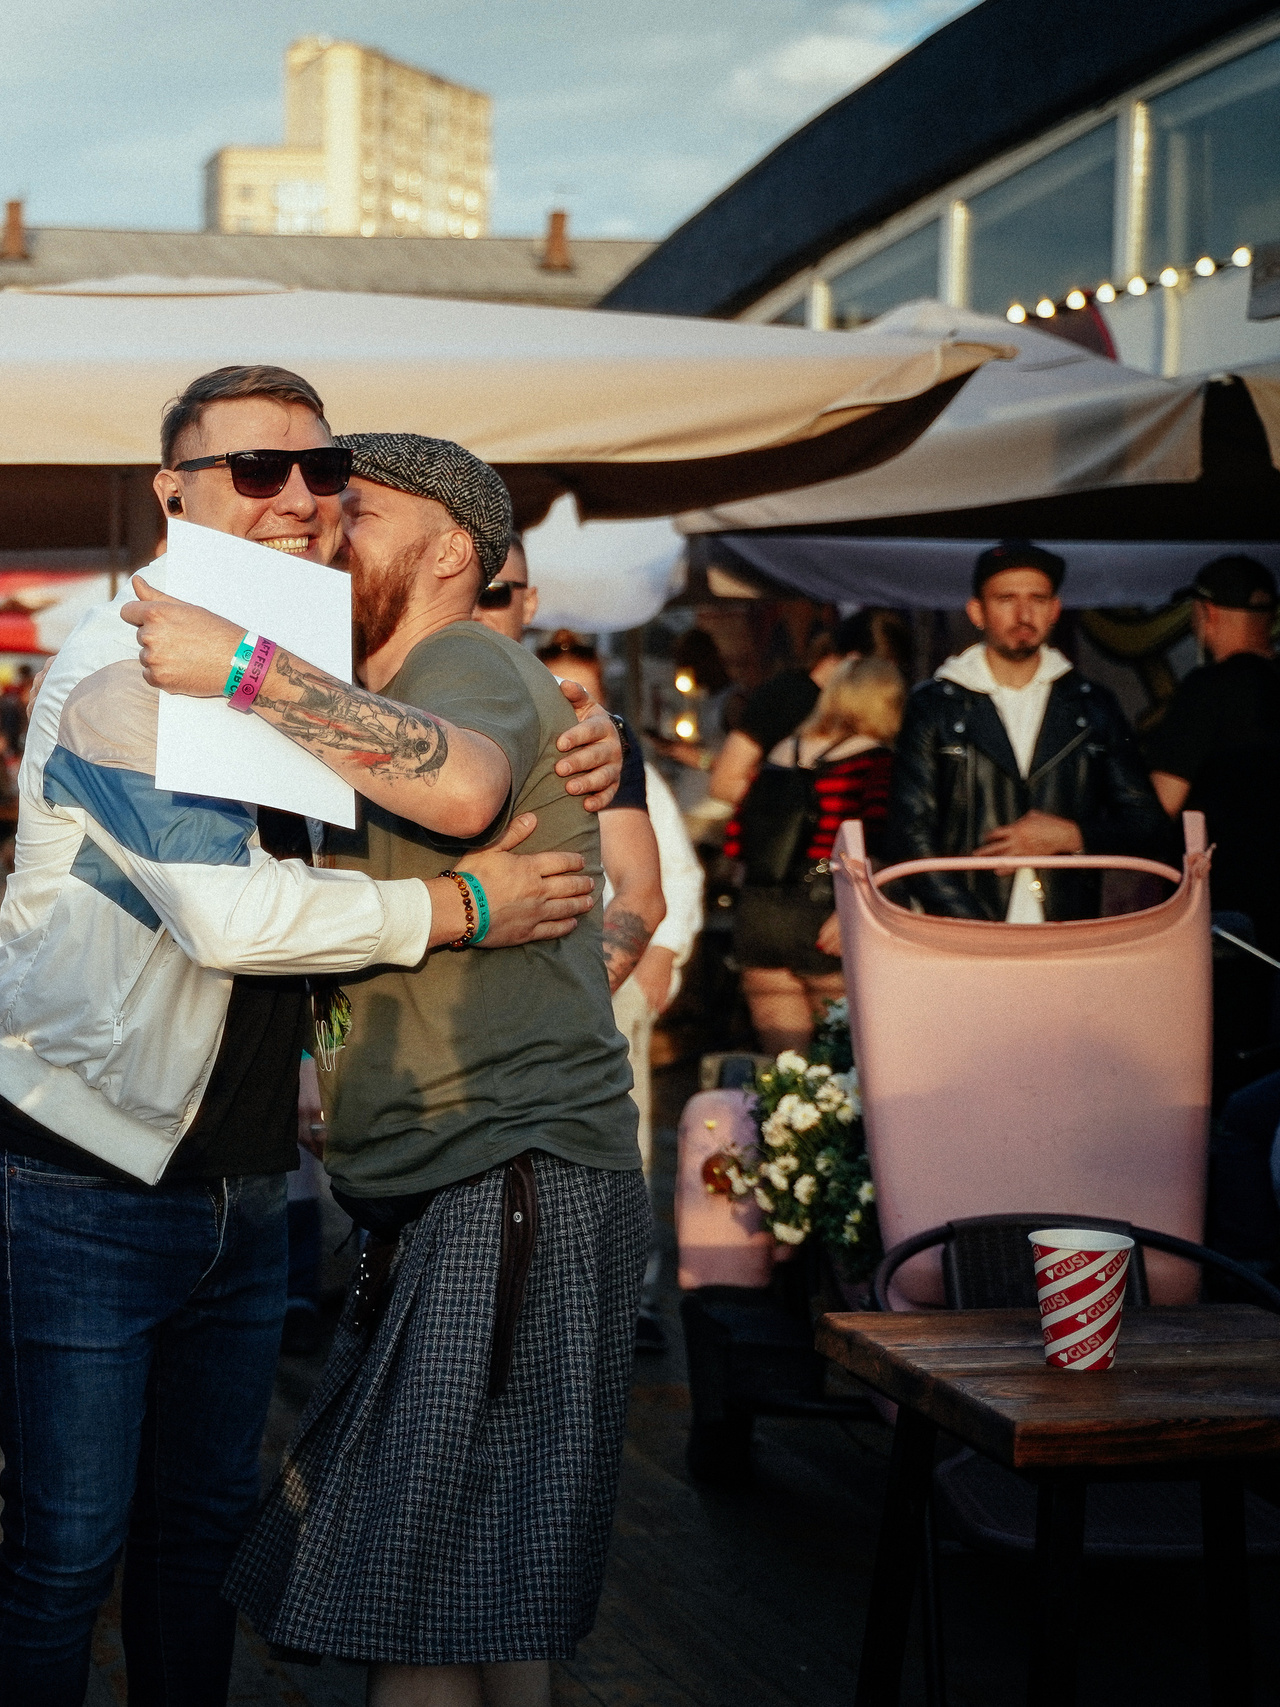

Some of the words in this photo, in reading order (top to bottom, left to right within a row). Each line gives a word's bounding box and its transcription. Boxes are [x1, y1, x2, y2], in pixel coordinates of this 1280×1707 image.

[249, 655, 266, 682] FEST
[1053, 1252, 1090, 1277] GUSI
[1042, 1292, 1070, 1314] GUSI
[1087, 1290, 1119, 1319] GUSI
[1067, 1333, 1104, 1359] GUSI
